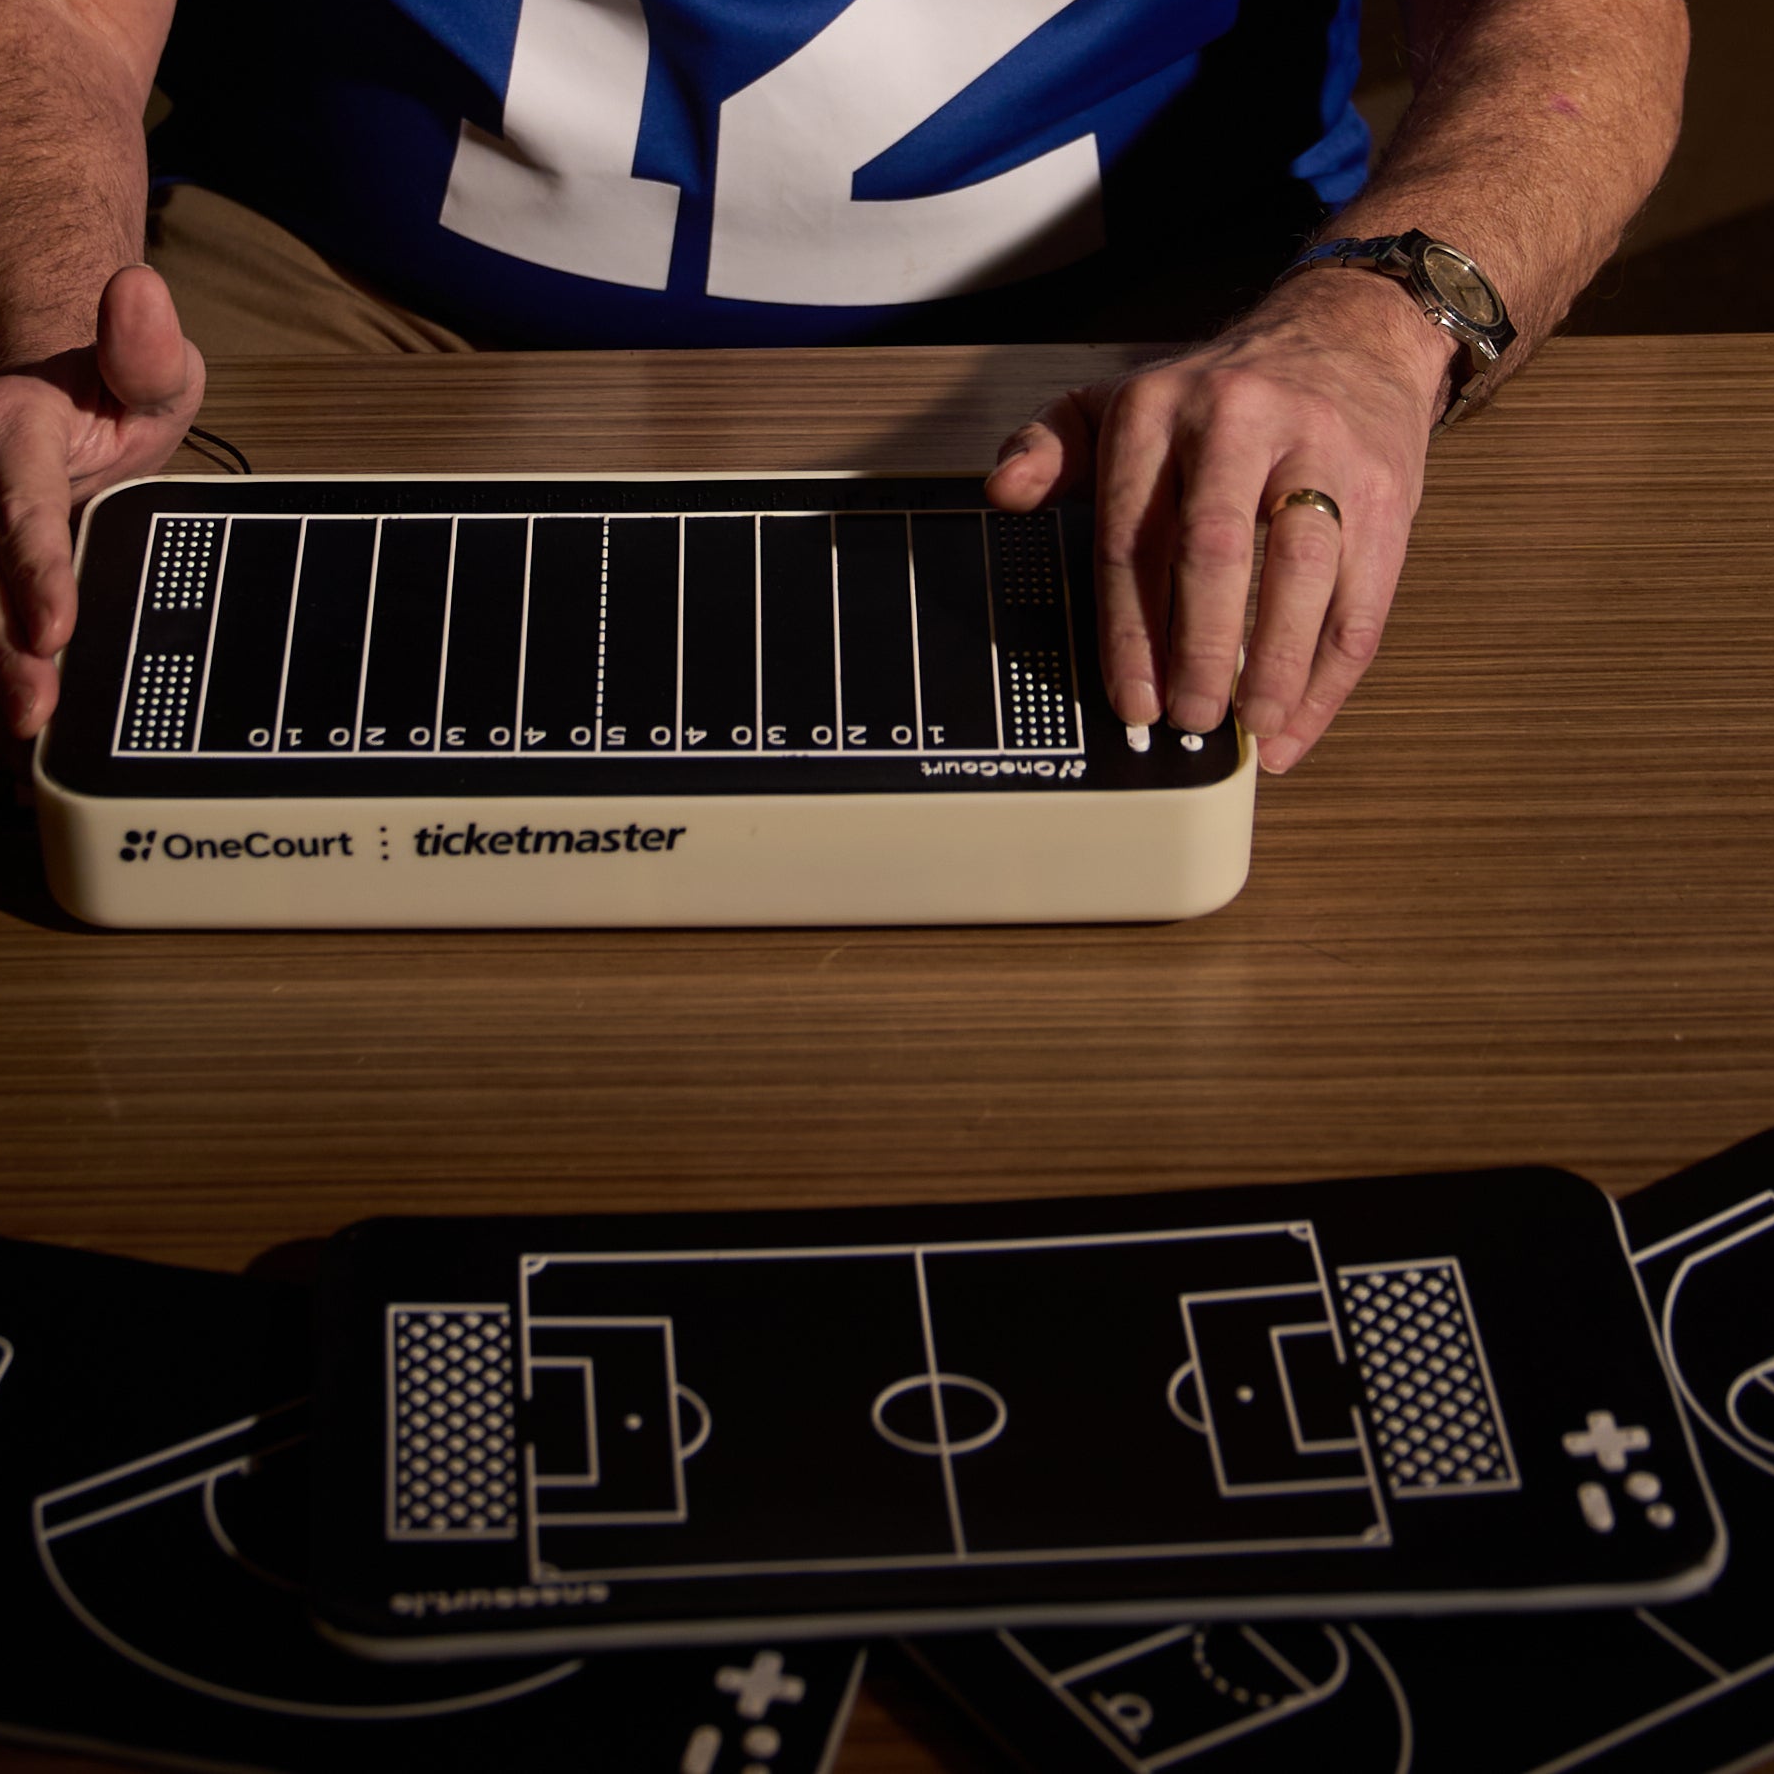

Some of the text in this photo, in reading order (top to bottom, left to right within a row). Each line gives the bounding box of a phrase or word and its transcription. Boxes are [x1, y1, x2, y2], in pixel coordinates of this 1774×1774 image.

[248, 726, 945, 746] 10 20 30 40 50 40 30 20 10
[920, 759, 1057, 778] OneCourt
[162, 822, 686, 861] OneCourt ticketmaster
